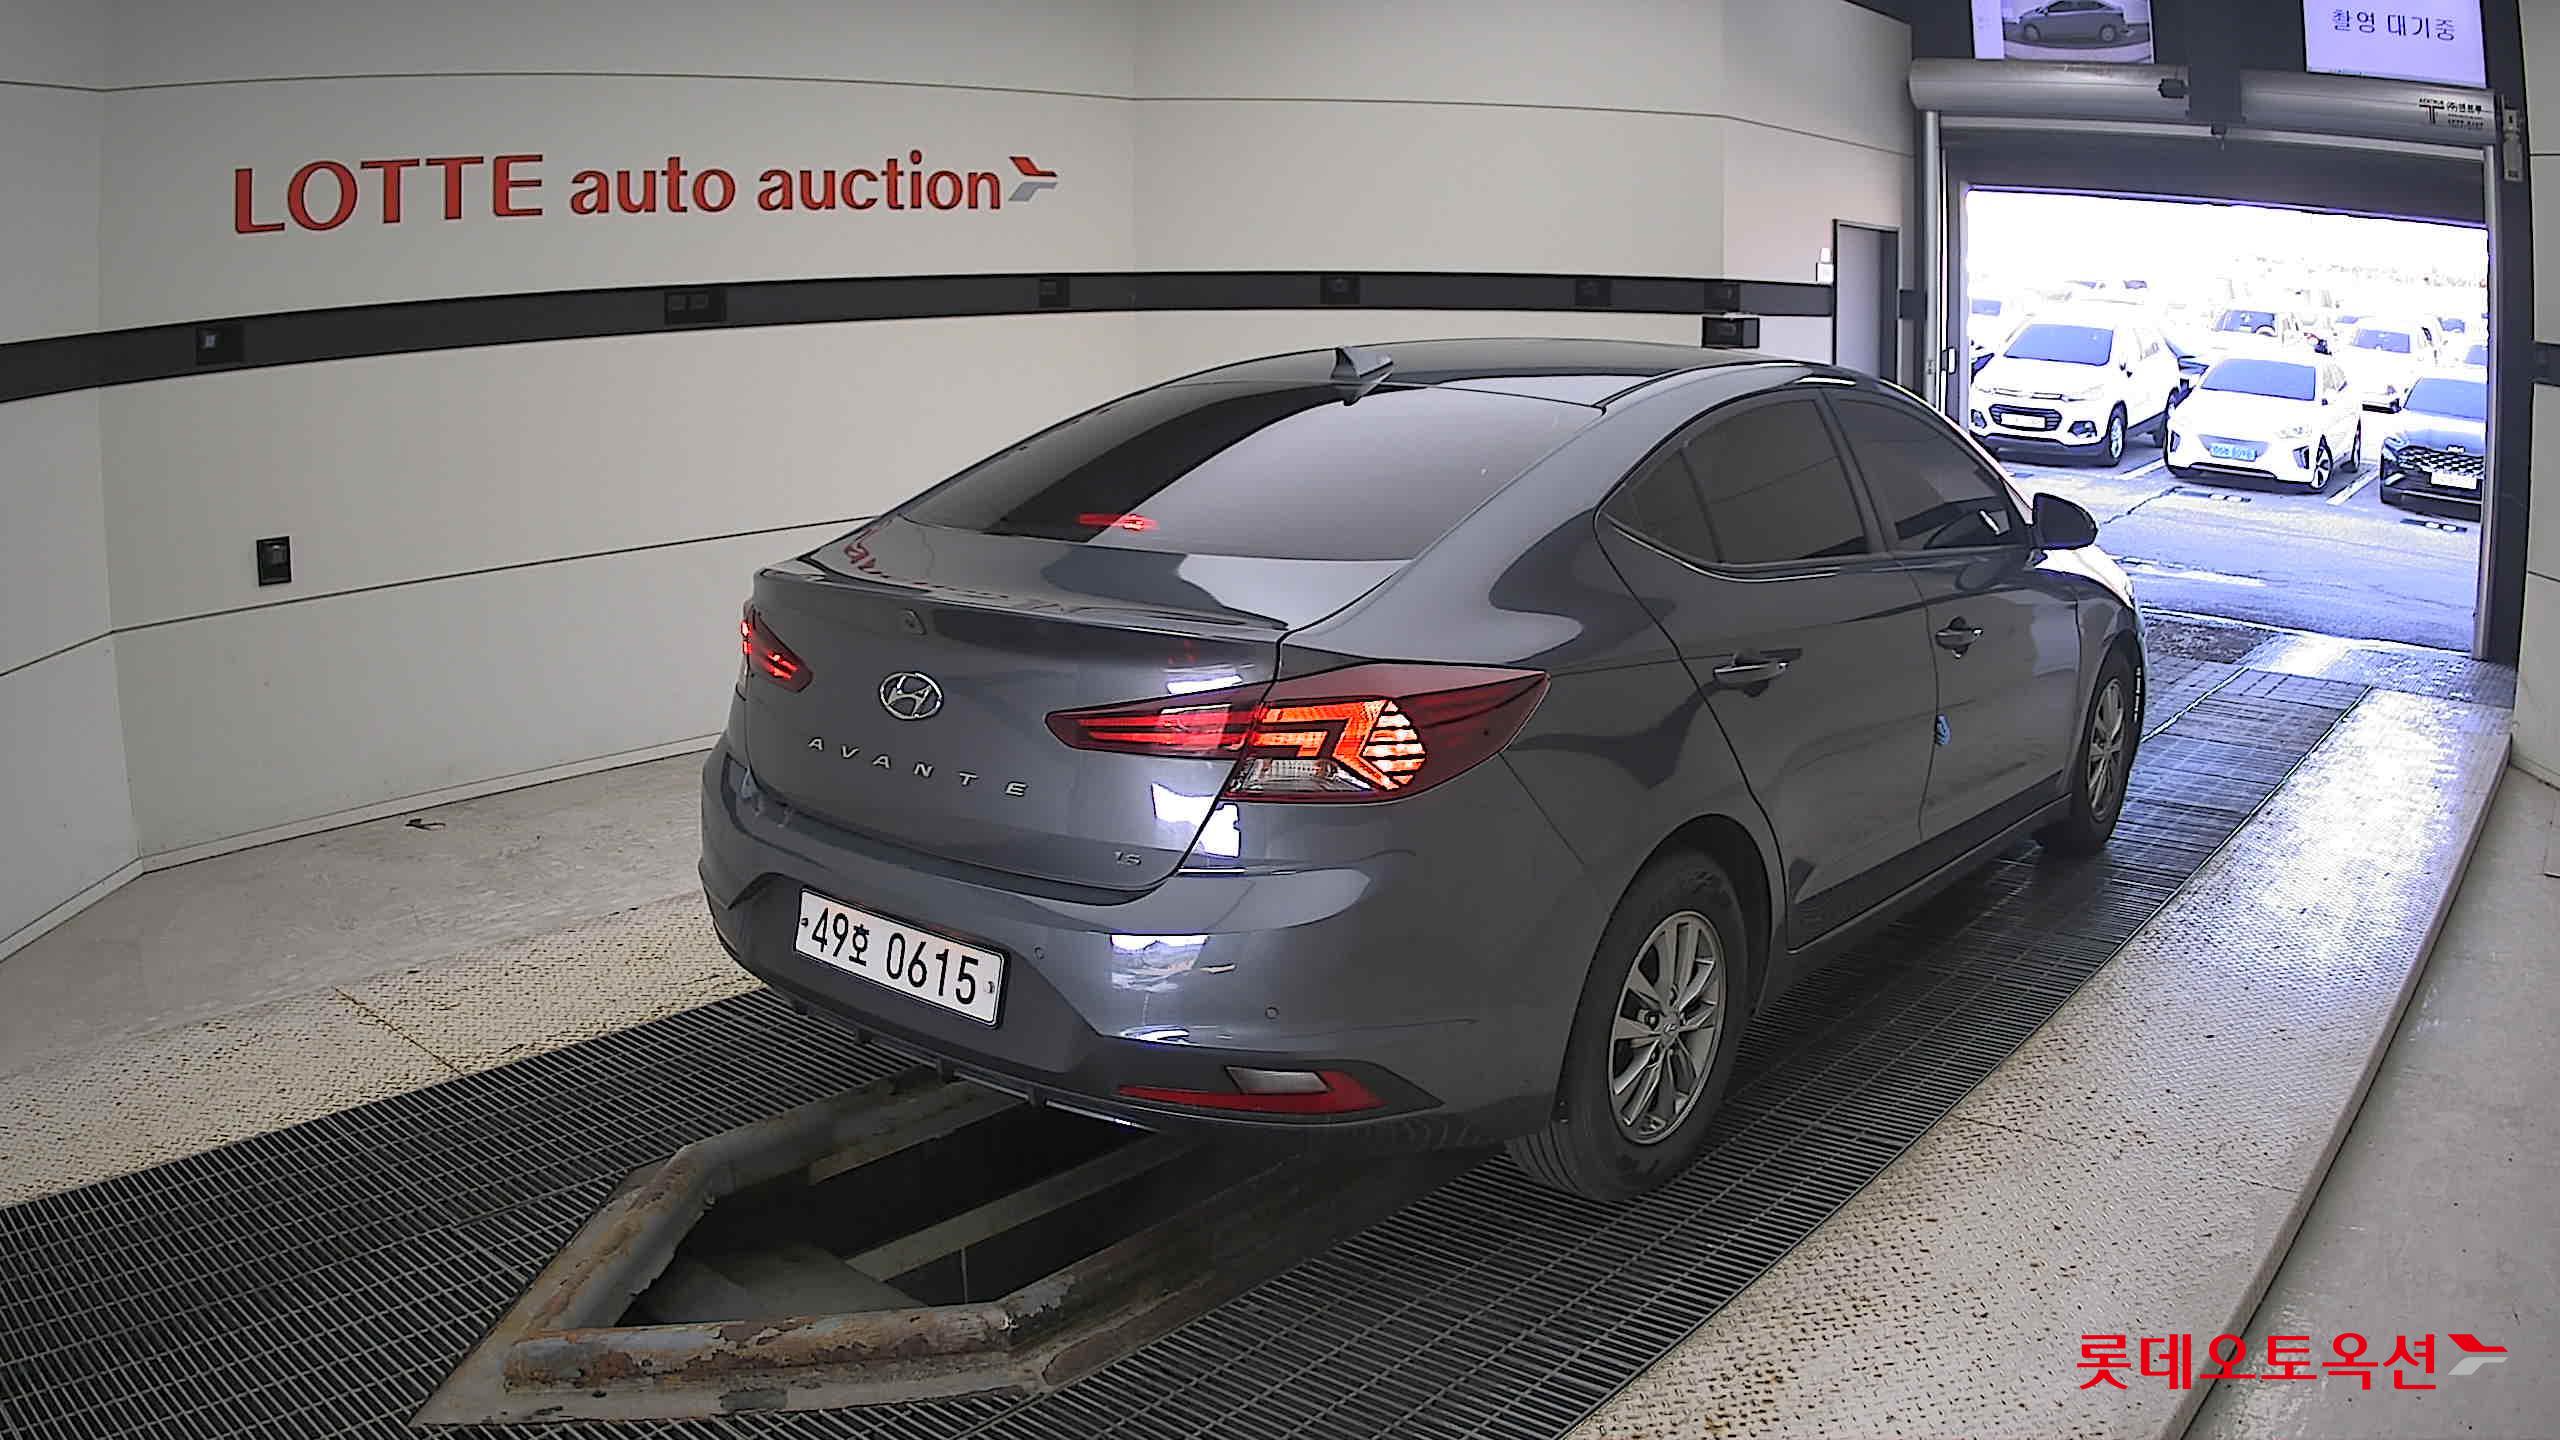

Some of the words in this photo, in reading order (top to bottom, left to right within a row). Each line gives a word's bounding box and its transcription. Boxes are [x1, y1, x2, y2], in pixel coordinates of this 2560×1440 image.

[2387, 13, 2455, 41] 대기중
[234, 154, 544, 235] LOTTE
[569, 156, 736, 214] auto
[757, 150, 1001, 211] auction
[807, 737, 1029, 799] AVANTE
[811, 907, 870, 967] 49호
[885, 932, 979, 1005] 0615
